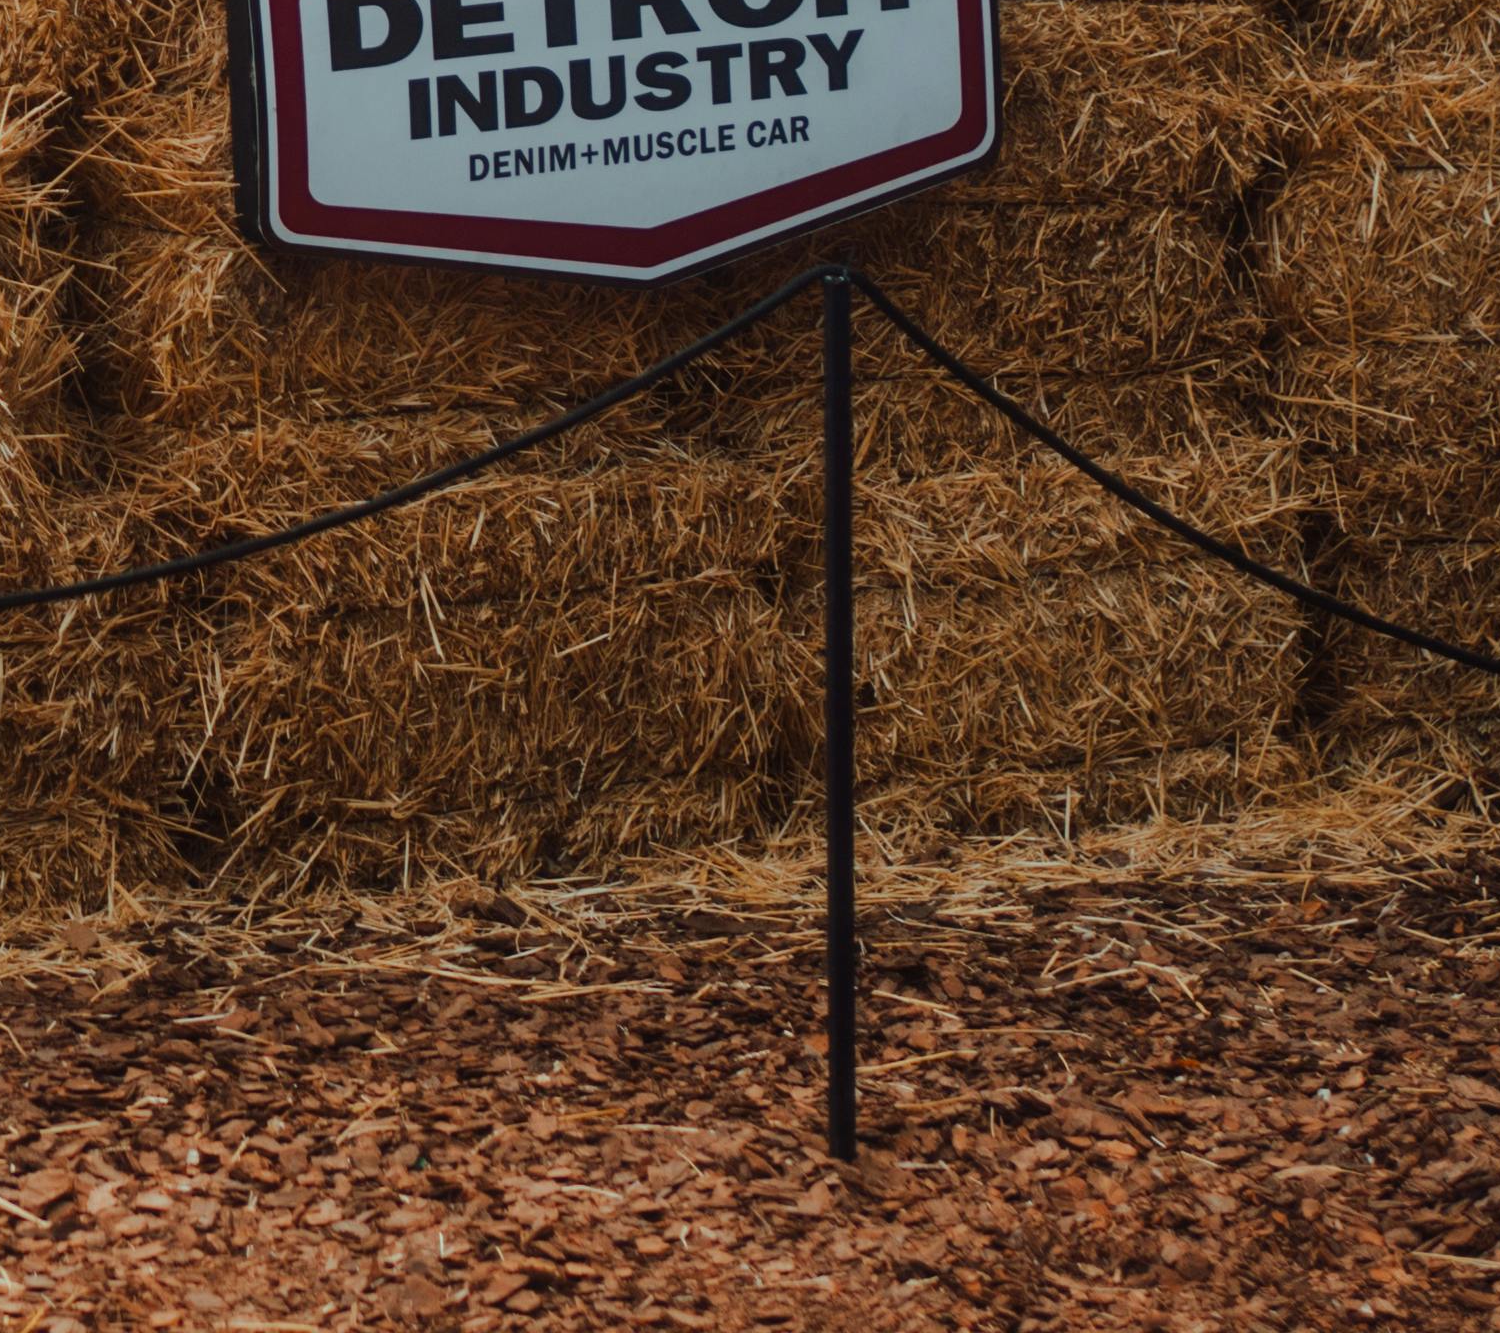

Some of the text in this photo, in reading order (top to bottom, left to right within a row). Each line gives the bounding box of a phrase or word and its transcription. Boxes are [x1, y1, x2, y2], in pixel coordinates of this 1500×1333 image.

[408, 28, 865, 141] INDUSTRY
[468, 115, 811, 183] DENIM+MUSCLE CAR
